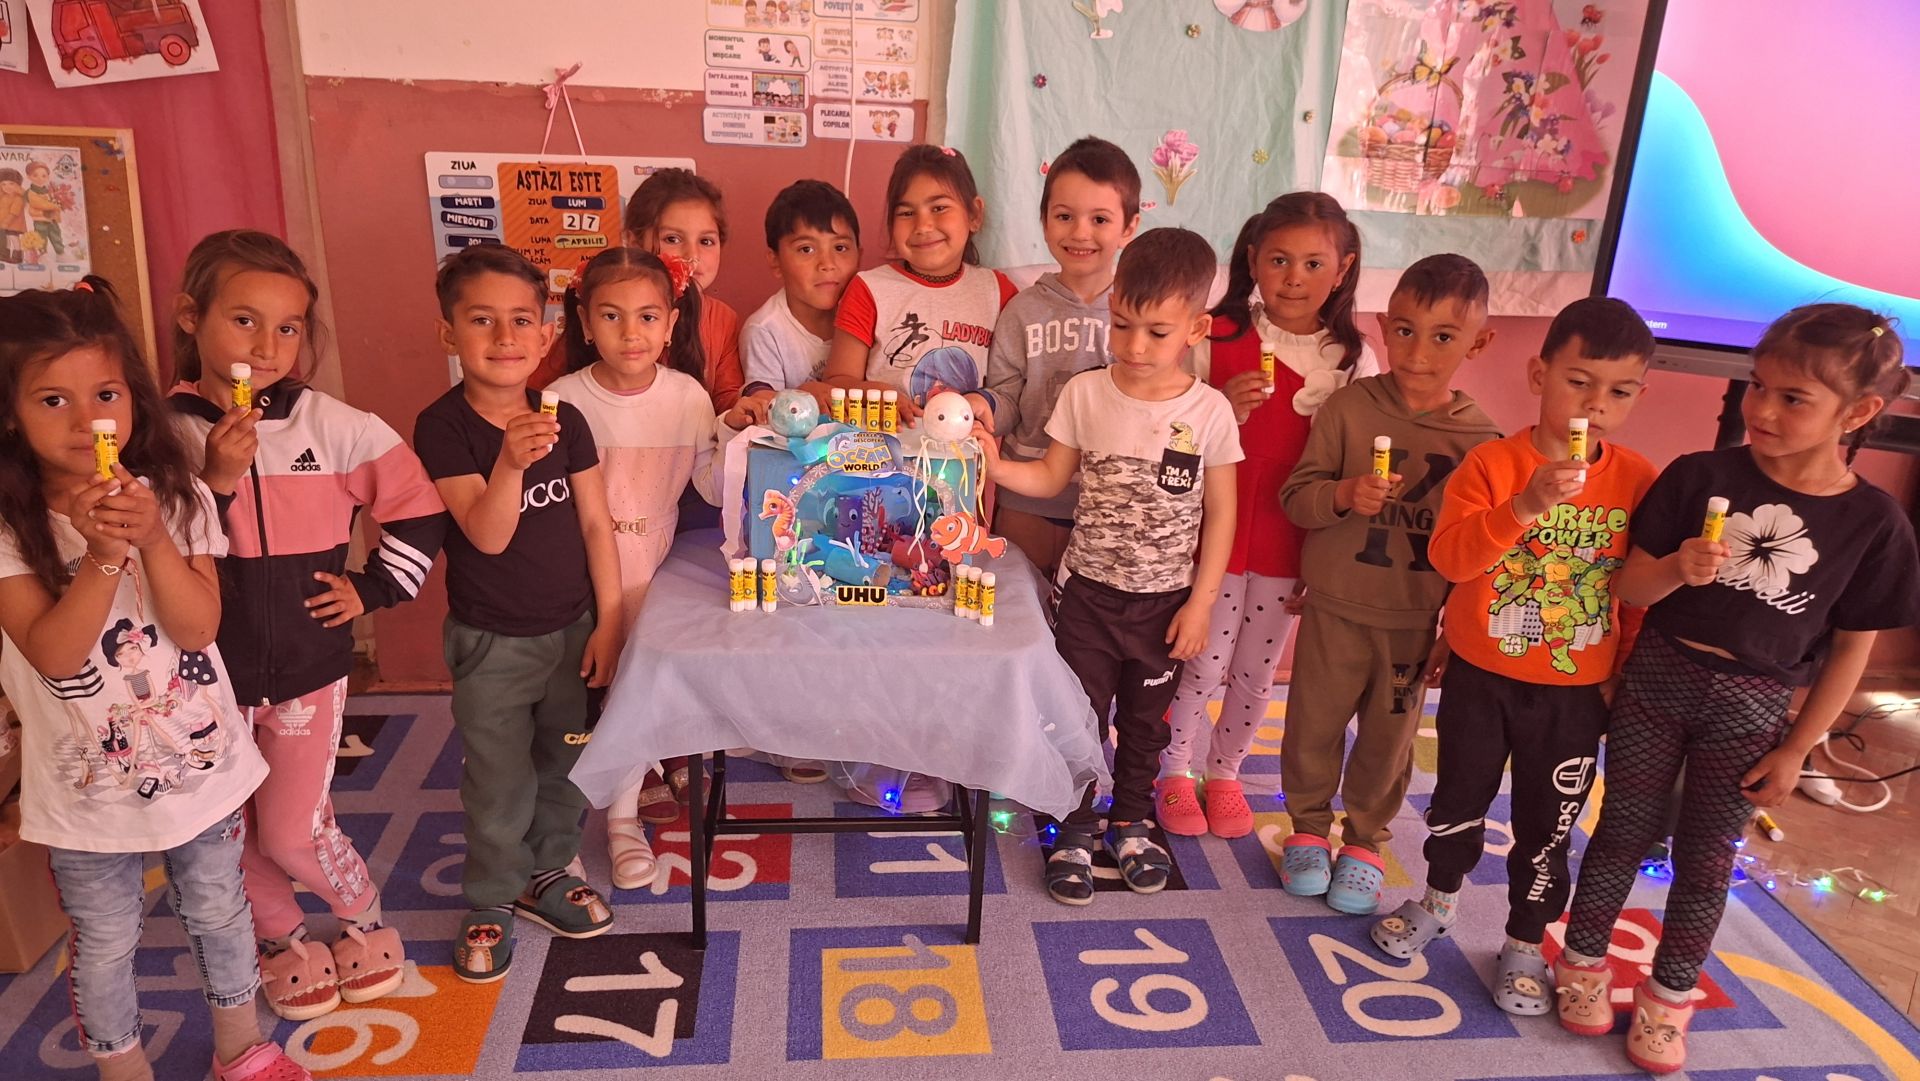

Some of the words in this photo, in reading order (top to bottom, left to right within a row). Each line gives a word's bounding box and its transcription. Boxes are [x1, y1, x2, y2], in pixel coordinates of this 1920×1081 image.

[708, 35, 745, 43] MOMENTUL
[820, 109, 850, 117] PLECAREA
[450, 160, 477, 170] ZIUA
[569, 171, 602, 192] ESTE
[528, 198, 548, 206] ZIUA
[446, 213, 488, 228] MIERCURI
[529, 216, 550, 225] DATA
[530, 235, 552, 244] LUNA
[570, 236, 604, 245] APRILIE
[828, 445, 892, 467] OCEAN
[290, 462, 321, 471] adidas
[844, 463, 880, 471] WORLD
[519, 477, 570, 513] UCCI
[1523, 526, 1613, 549] POWER
[838, 587, 886, 602] UHU
[279, 728, 311, 736] adidas
[837, 933, 959, 1042] 18
[1078, 928, 1209, 1033] 19
[1308, 933, 1461, 1038] 20
[554, 951, 684, 1058] 17
